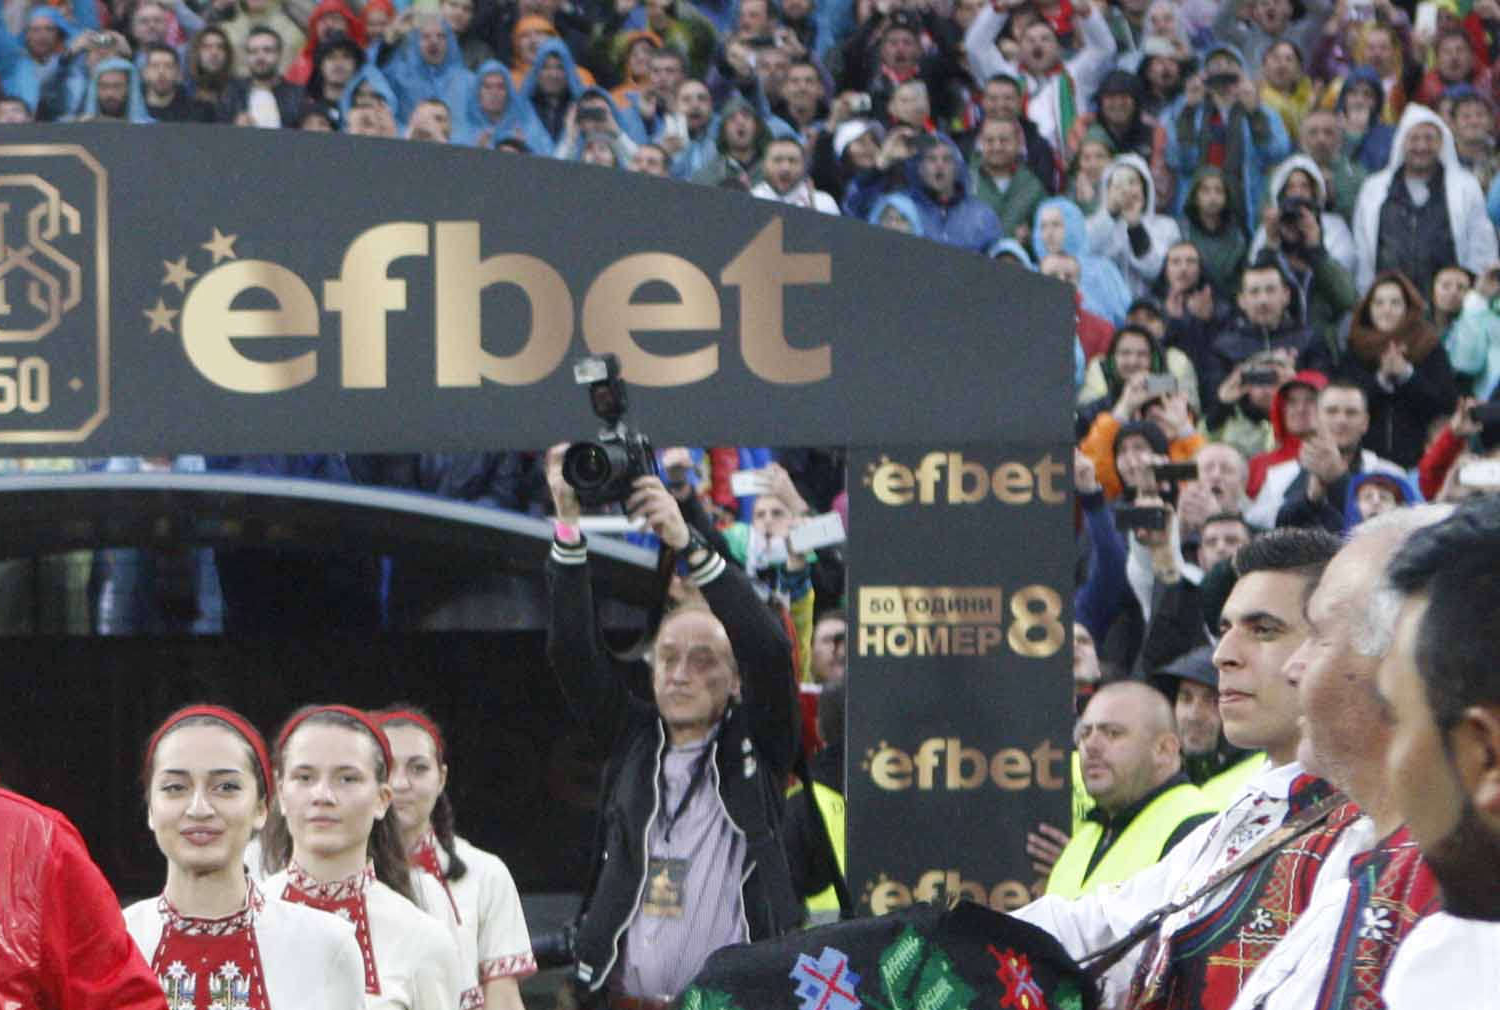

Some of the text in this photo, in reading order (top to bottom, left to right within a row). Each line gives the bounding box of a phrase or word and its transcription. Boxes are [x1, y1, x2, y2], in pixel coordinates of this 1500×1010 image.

[180, 216, 832, 394] efbet
[871, 451, 1067, 505] efbet
[858, 585, 1066, 658] НОМЕР 8
[868, 595, 993, 616] 50 ГОДИНИ
[870, 736, 1065, 791] efbet
